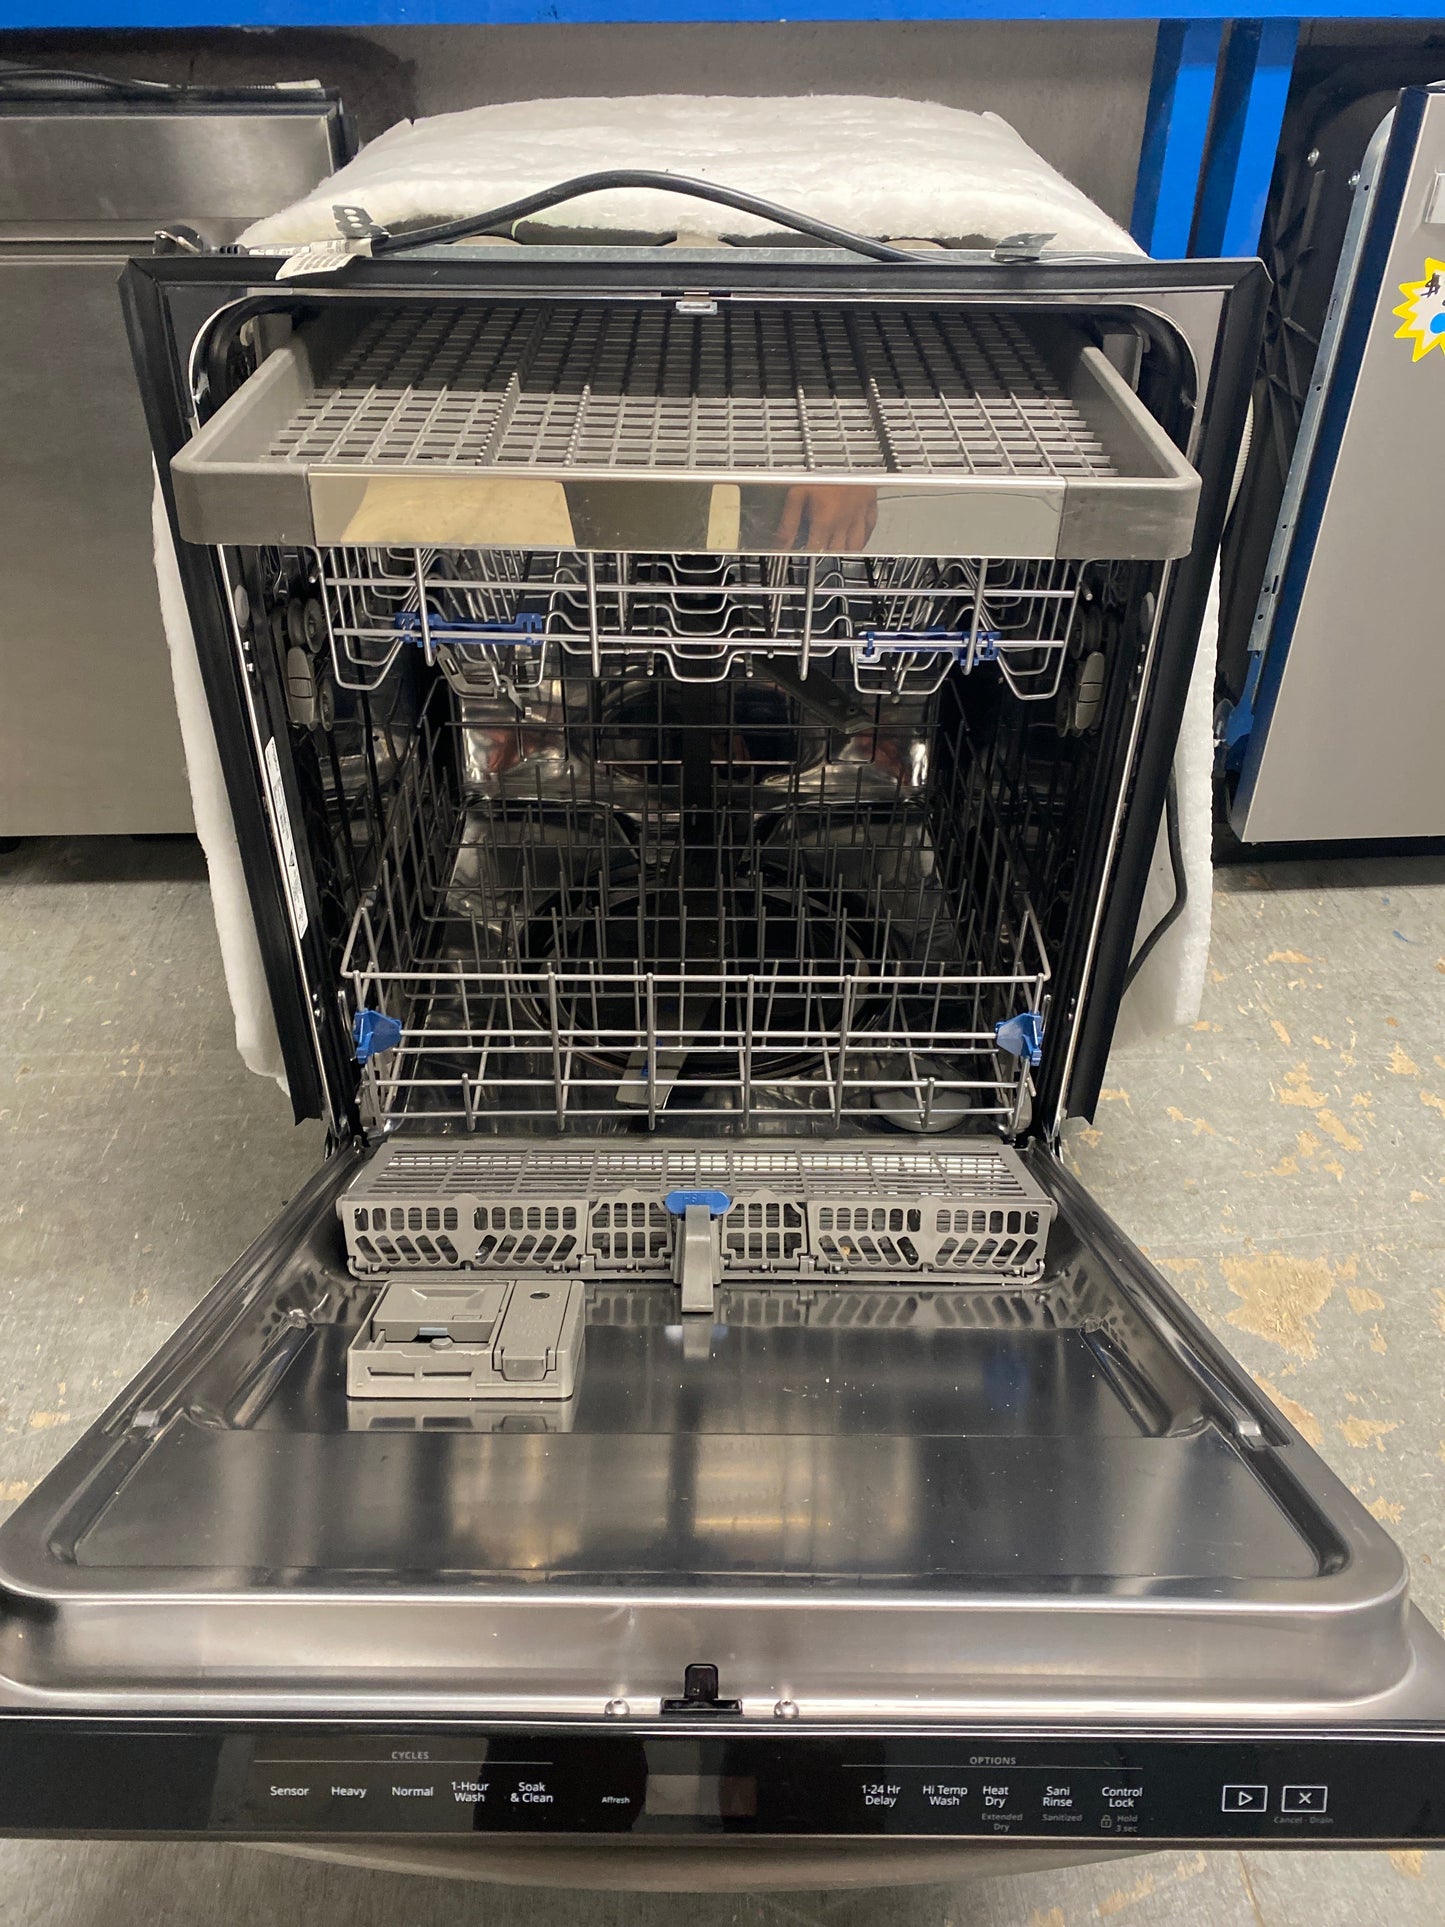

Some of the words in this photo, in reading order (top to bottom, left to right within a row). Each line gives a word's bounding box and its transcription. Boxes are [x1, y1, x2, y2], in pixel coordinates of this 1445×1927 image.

[391, 1751, 430, 1760] CYCLES
[969, 1756, 1017, 1766] OPTIONS
[270, 1786, 310, 1797] Sensor
[391, 1786, 434, 1797] Normal
[451, 1781, 490, 1792] 1-Hour
[518, 1781, 546, 1792] Soak
[861, 1784, 884, 1795] 1-24
[887, 1785, 901, 1795] Hr
[922, 1785, 935, 1795] Hi
[938, 1785, 968, 1797] Temp
[982, 1786, 1009, 1796] Heat
[1046, 1786, 1071, 1796] Sani
[1101, 1786, 1143, 1797] Control
[331, 1786, 368, 1799] Heavy
[454, 1792, 486, 1803] Wash
[510, 1793, 520, 1803] &
[522, 1792, 553, 1803] Clean
[601, 1796, 631, 1804] Affresh
[865, 1795, 897, 1808] Delay
[930, 1796, 960, 1806] Wash
[985, 1796, 1007, 1809] Dry
[1042, 1797, 1073, 1807] Rinse
[1108, 1798, 1135, 1808] Lock
[981, 1812, 1024, 1821] Extended
[1041, 1813, 1083, 1822] Sanitized
[1116, 1814, 1139, 1823] Hold
[993, 1823, 1010, 1832] Dry
[1115, 1824, 1122, 1833] 3
[1123, 1825, 1138, 1833] sec
